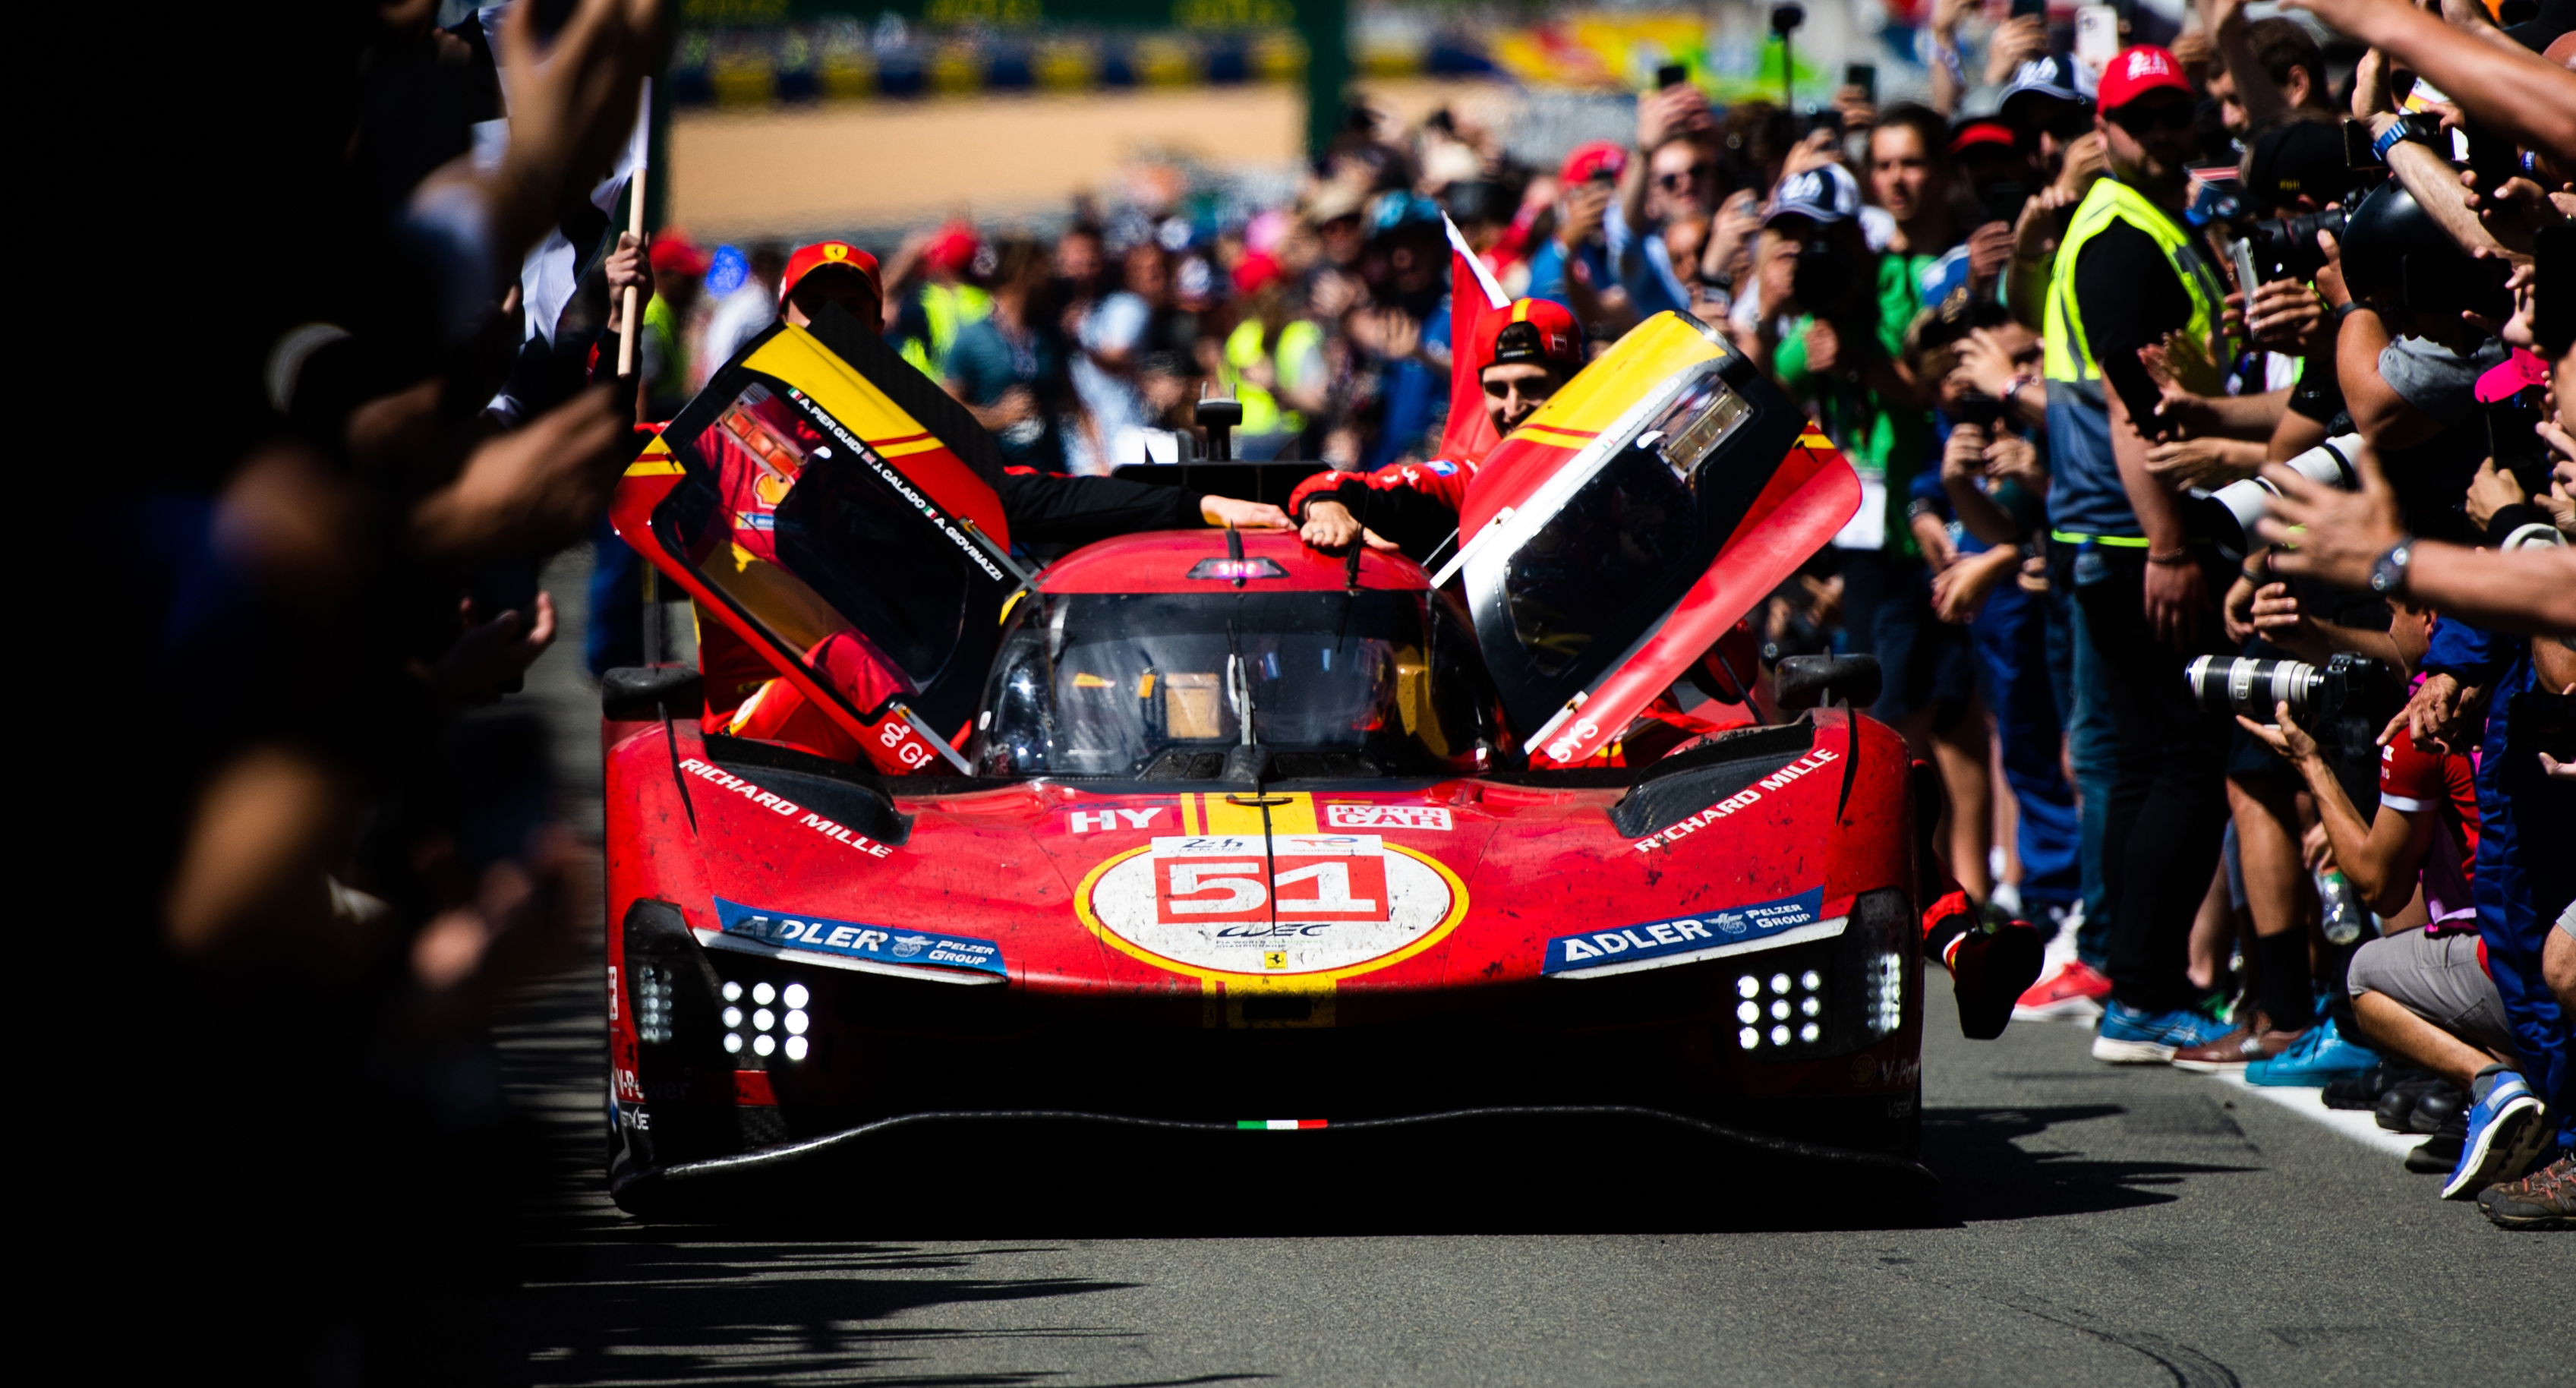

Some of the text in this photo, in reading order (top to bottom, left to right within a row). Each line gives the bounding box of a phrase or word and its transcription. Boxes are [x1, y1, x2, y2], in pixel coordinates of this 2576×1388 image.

[810, 405, 837, 431] PIER
[833, 427, 865, 455] GUIDI
[881, 468, 926, 509] CALADO
[945, 526, 1004, 581] GIOVINAZZI
[1547, 718, 1599, 763] SYS
[1759, 748, 1839, 790] MILLE
[679, 759, 893, 858] RICHARD MILLE
[1070, 807, 1162, 833] HY
[1335, 807, 1442, 815] HYPER
[1337, 813, 1442, 827] CAR
[1169, 862, 1376, 914] 51
[1745, 904, 1802, 920] PELZER
[1756, 913, 1811, 929] GROUP
[731, 916, 889, 952] ADLER
[1216, 923, 1331, 937] WEC
[1562, 920, 1712, 962] ADLER
[929, 950, 987, 965] GROUP
[936, 939, 995, 955] PELZER
